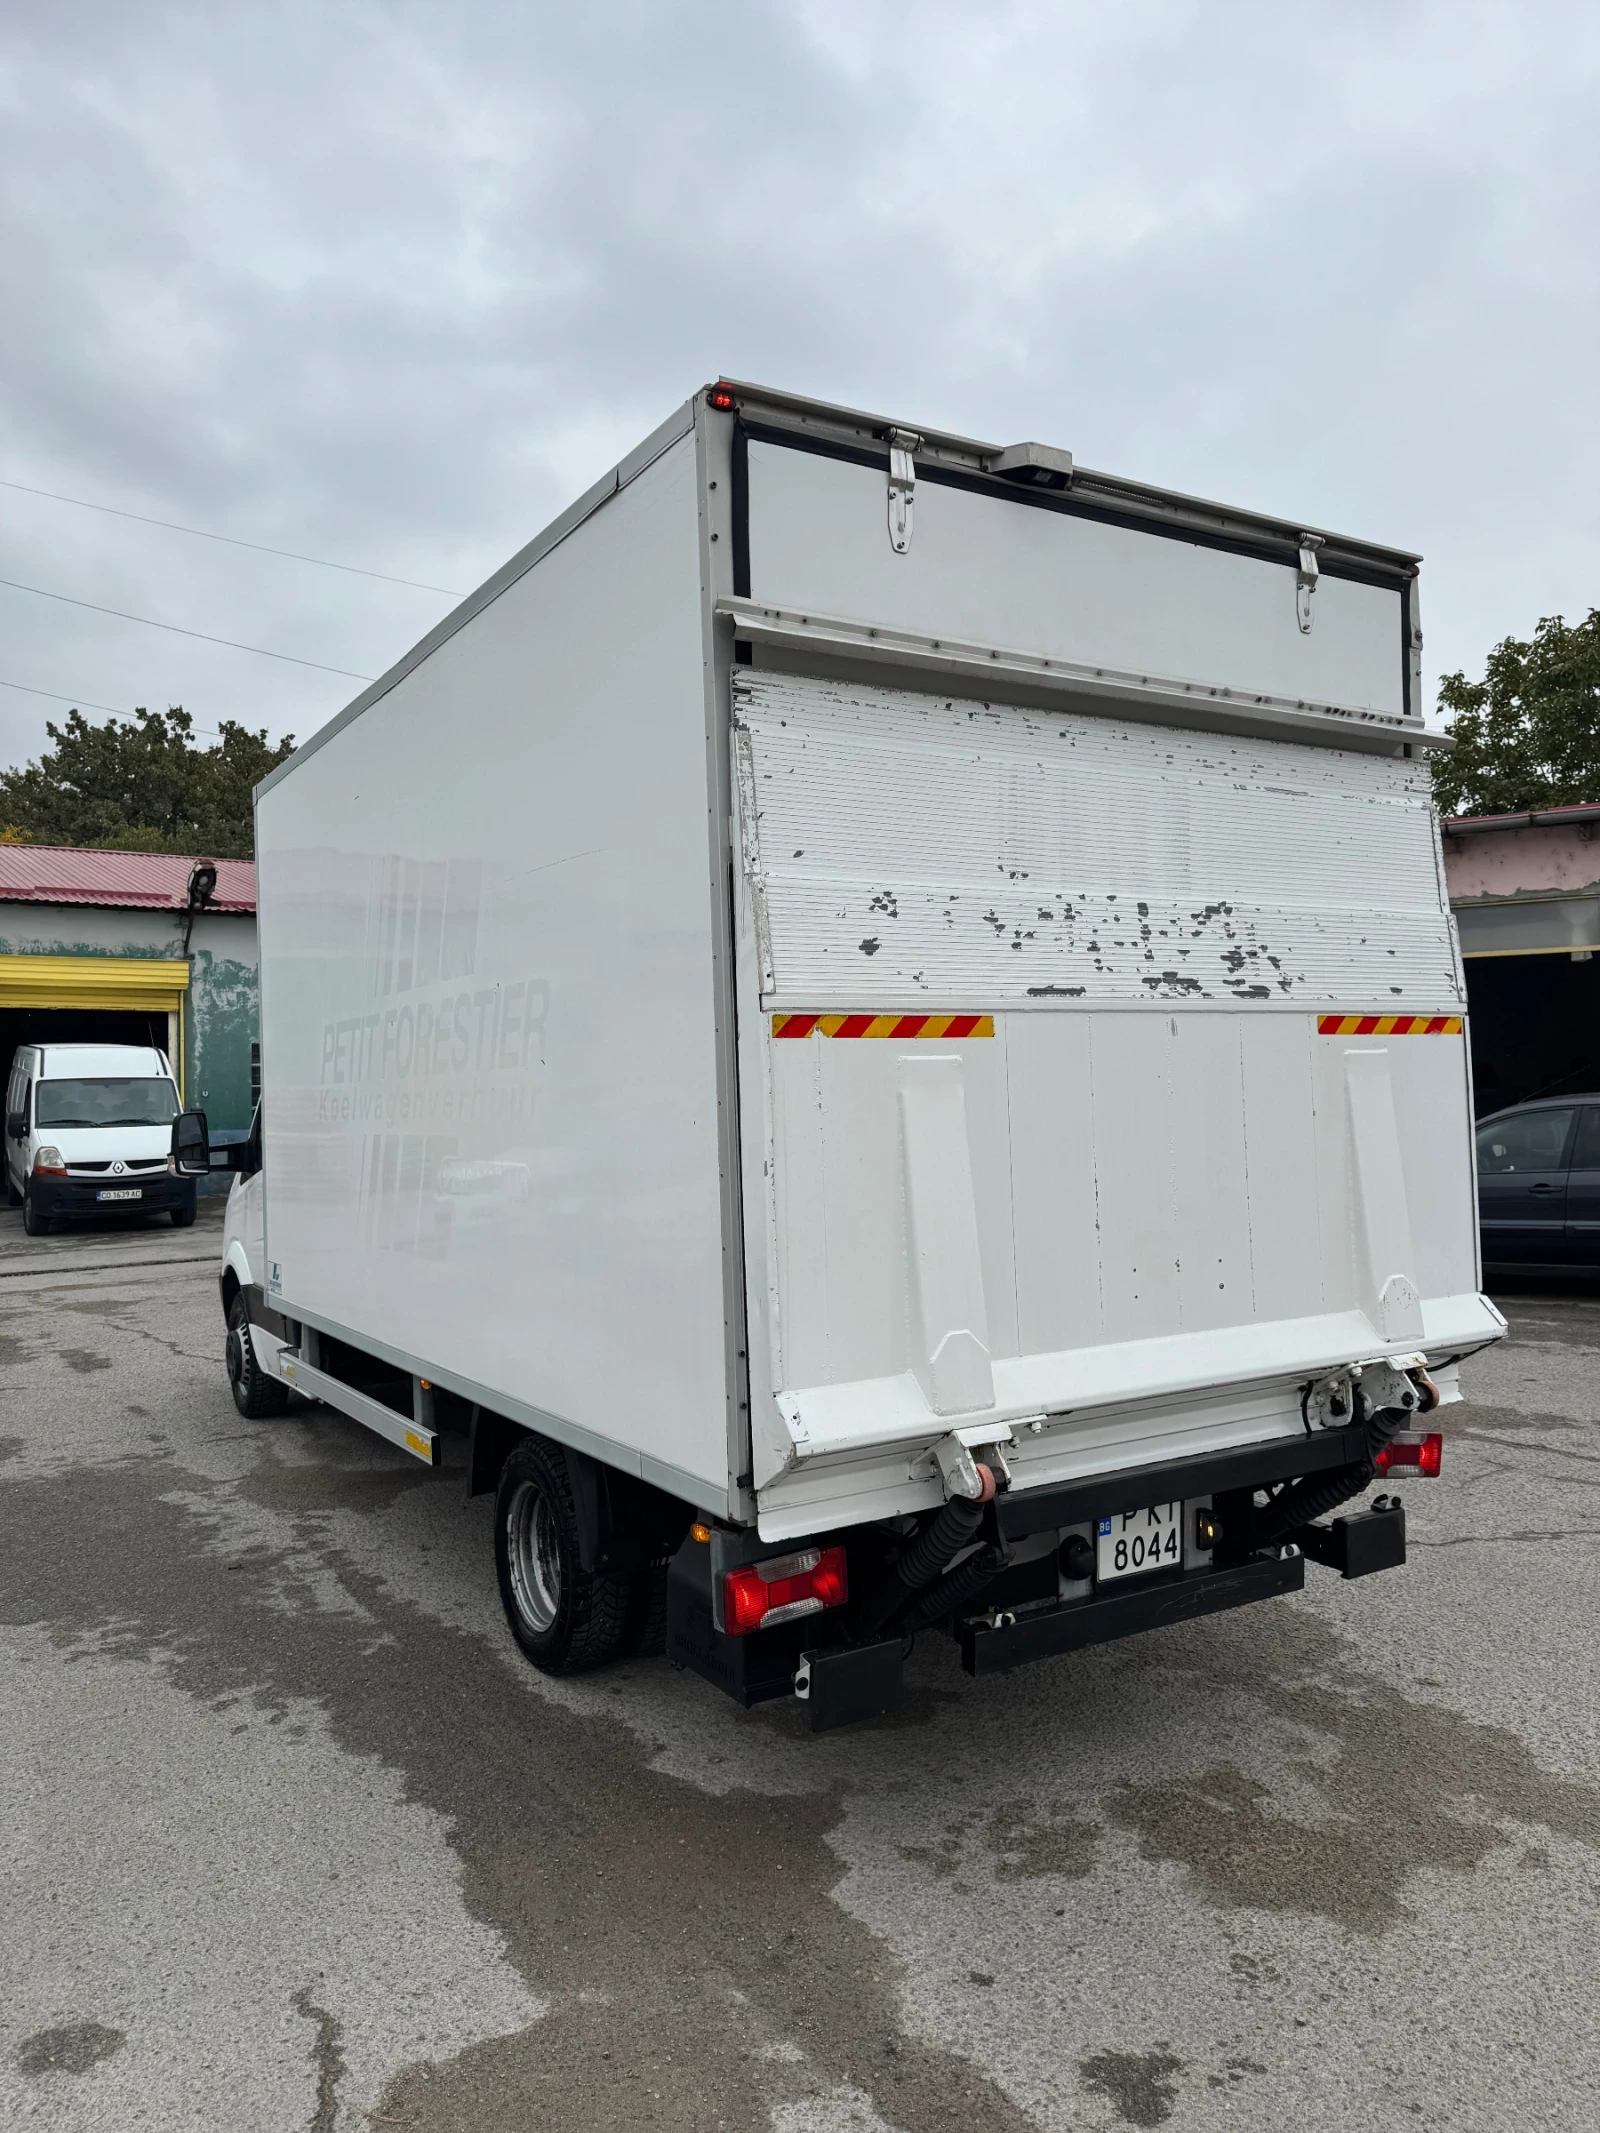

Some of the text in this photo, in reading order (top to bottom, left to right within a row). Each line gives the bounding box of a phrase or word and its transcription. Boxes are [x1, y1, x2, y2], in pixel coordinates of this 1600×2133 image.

[319, 977, 551, 1085] PETIT FORESTIER
[318, 1079, 545, 1127] Koelwagenverhuur
[1099, 1522, 1110, 1532] BG
[1114, 1527, 1178, 1571] 8044
